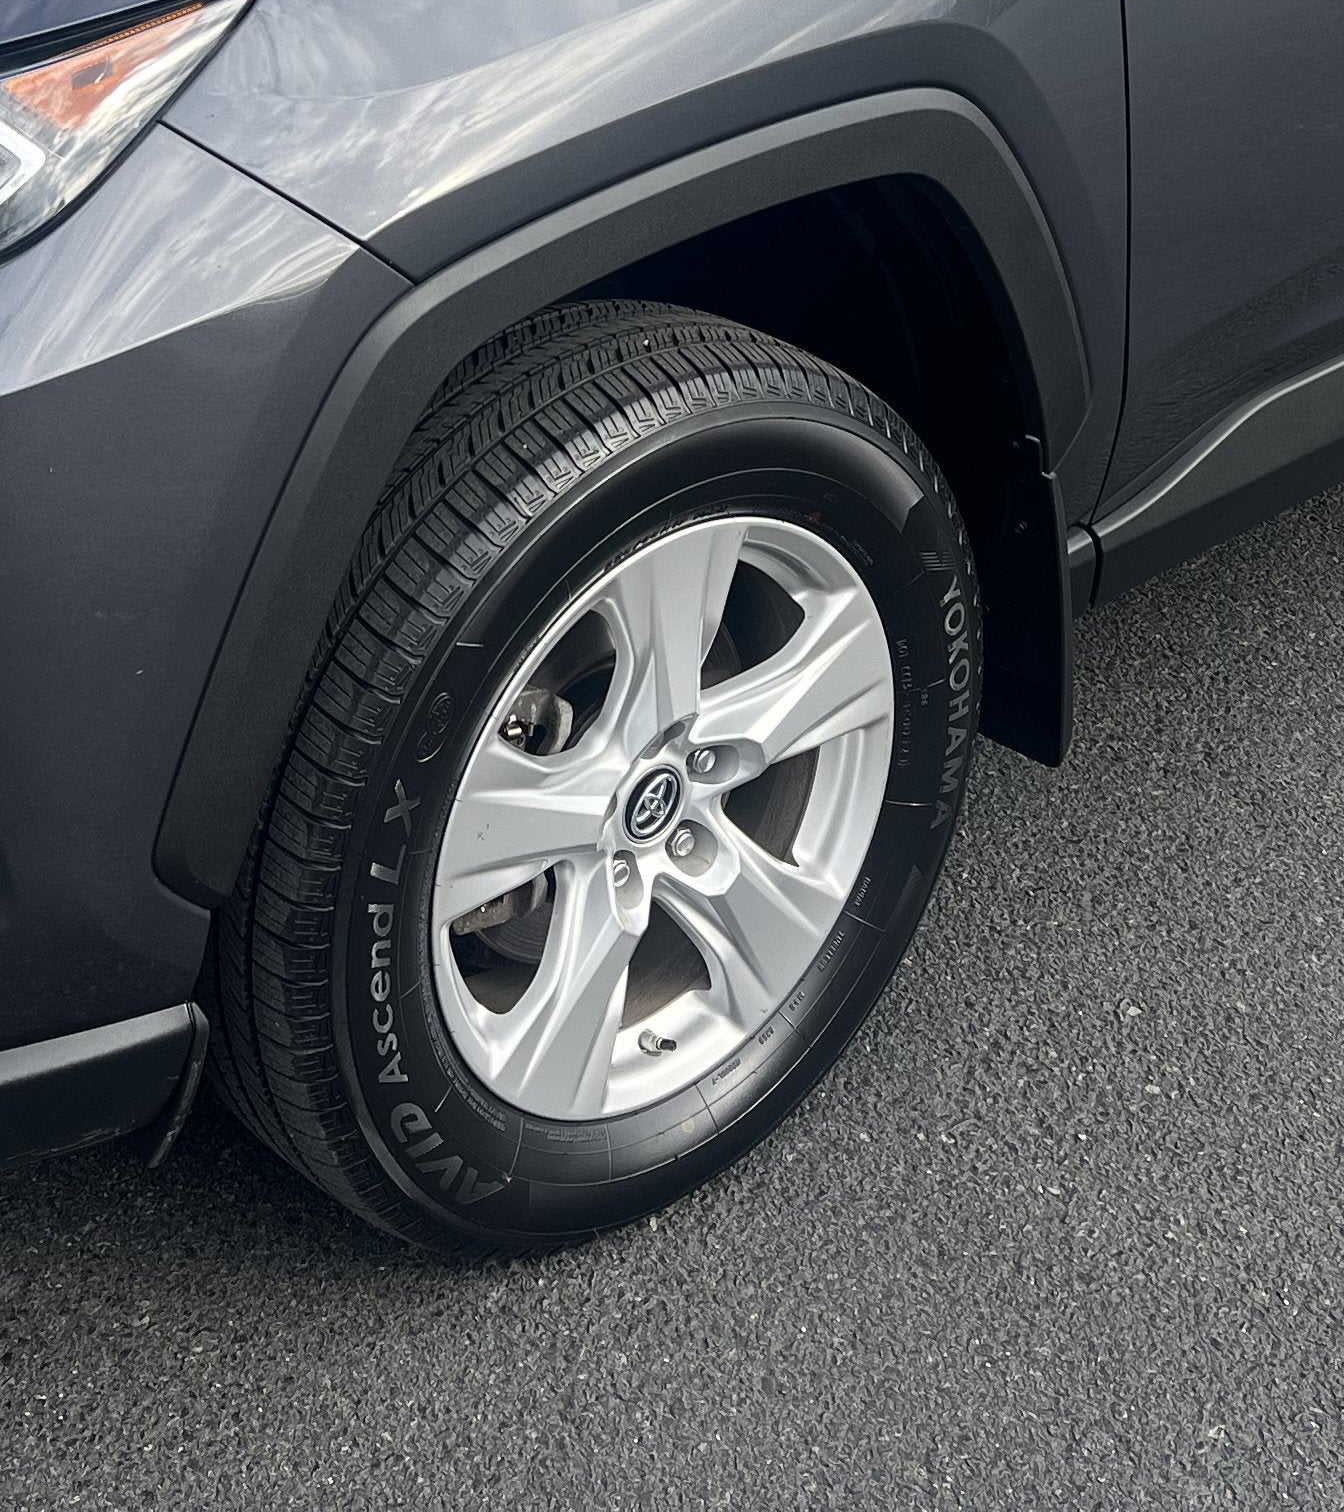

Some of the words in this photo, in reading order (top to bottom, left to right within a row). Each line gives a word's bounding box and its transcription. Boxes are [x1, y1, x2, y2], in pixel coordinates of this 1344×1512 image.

[930, 575, 970, 829] YOKOHAMA
[367, 904, 408, 1083] Ascend
[390, 1102, 505, 1205] AVID
